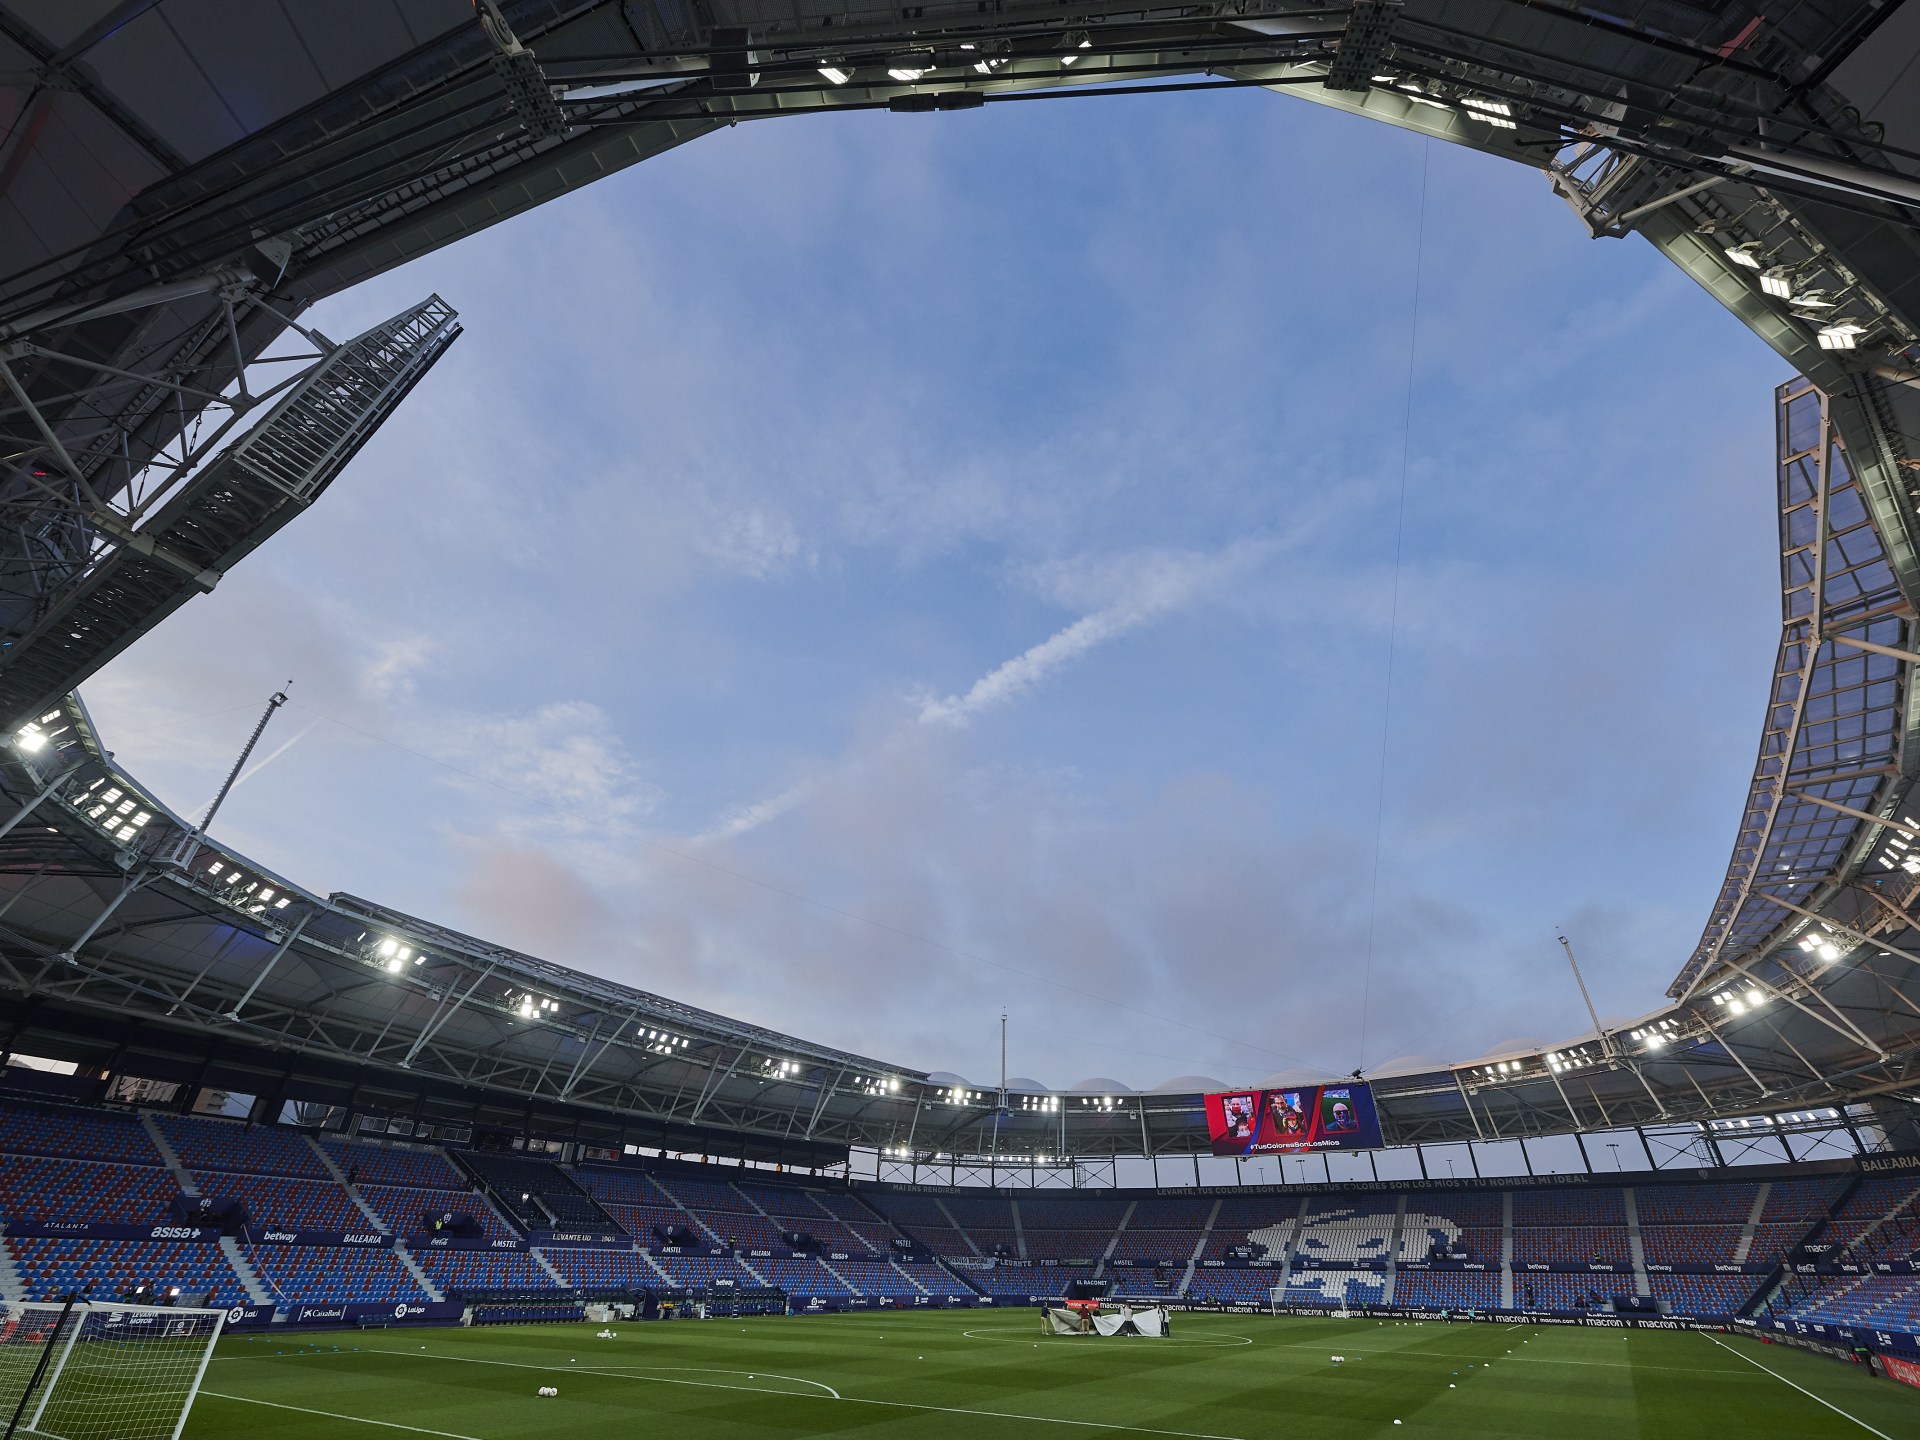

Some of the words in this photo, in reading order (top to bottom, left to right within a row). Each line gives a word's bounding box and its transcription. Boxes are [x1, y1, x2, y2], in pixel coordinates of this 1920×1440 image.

[892, 1183, 906, 1191] MAI
[907, 1184, 922, 1192] ENS
[923, 1185, 961, 1194] RENDIREM
[1199, 1187, 1213, 1195] TUS
[1215, 1186, 1254, 1194] COLORES
[1256, 1185, 1274, 1193] SON
[1324, 1183, 1341, 1191] TUS
[1389, 1180, 1410, 1189] SON
[1413, 1180, 1432, 1188] LOS
[1472, 1178, 1486, 1187] TU
[1489, 1176, 1536, 1187] NOMBRE
[1537, 1176, 1551, 1185] MI
[1554, 1174, 1588, 1184] IDEAL
[43, 1222, 89, 1230] ATALANTA
[264, 1231, 297, 1242] betway
[343, 1234, 382, 1244] BALEARIA
[552, 1233, 582, 1242] LEVANTE
[491, 1239, 517, 1248] AMSTEL
[662, 1246, 682, 1254] AMSTEL
[792, 1251, 807, 1259] betway
[1000, 1259, 1032, 1267] LEVANTE
[1249, 1259, 1272, 1267] macron
[1463, 1262, 1485, 1270] betway
[1527, 1263, 1550, 1272] betway
[1589, 1263, 1613, 1272] betway
[1646, 1263, 1672, 1272] betway
[1714, 1263, 1742, 1273] betway
[715, 1279, 735, 1288] betway
[1083, 1279, 1108, 1287] RACONET
[312, 1309, 341, 1318] CaixaBank
[407, 1306, 425, 1314] LaLiga
[1226, 1306, 1253, 1314] macron
[1296, 1308, 1324, 1316] macron
[1495, 1314, 1530, 1324] macron
[1539, 1317, 1576, 1325] macron.com
[1586, 1317, 1624, 1328] macron
[1638, 1319, 1678, 1330] macron
